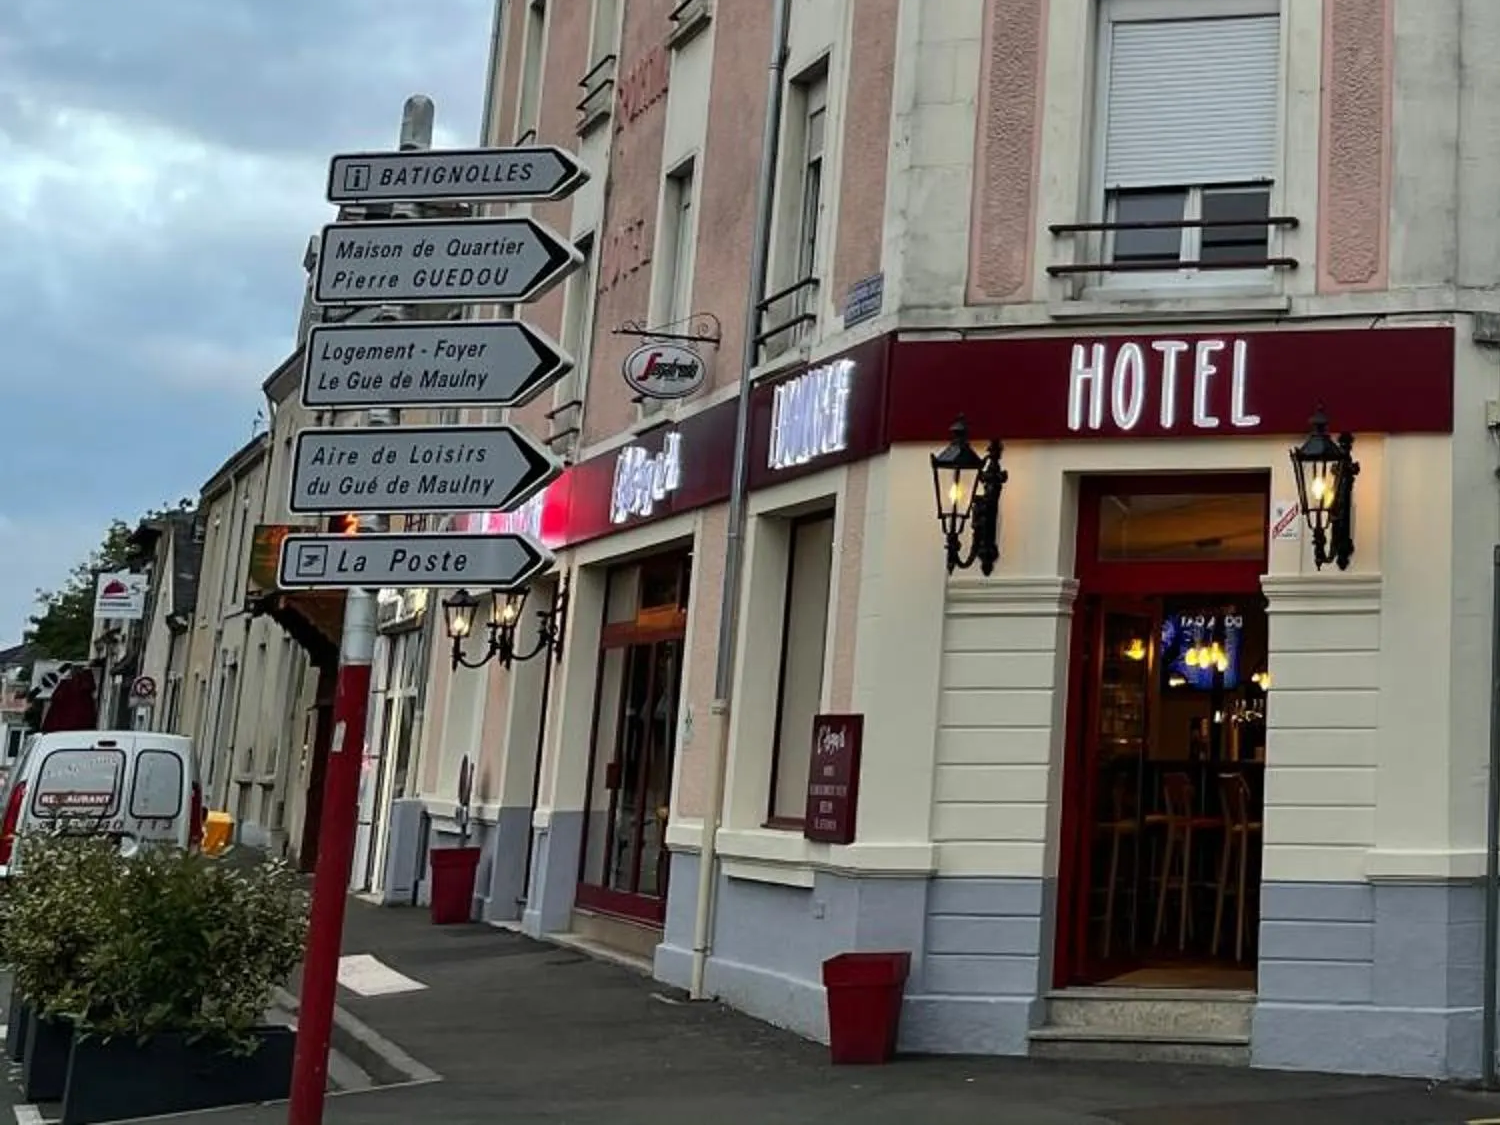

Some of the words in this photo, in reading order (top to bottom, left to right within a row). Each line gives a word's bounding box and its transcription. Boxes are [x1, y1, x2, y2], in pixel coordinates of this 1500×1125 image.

[379, 162, 534, 187] BATIGNOLLES
[335, 240, 403, 260] Maison
[412, 239, 435, 258] de
[446, 236, 525, 257] Quartier
[331, 270, 399, 290] Pierre
[412, 267, 509, 288] GUEDOU
[321, 341, 416, 365] Logement
[433, 339, 488, 363] Foyer
[317, 372, 339, 390] Le
[389, 371, 413, 388] de
[419, 370, 489, 391] Maulny
[1067, 338, 1261, 432] HOTEL
[311, 445, 359, 466] Aire
[371, 445, 397, 465] de
[409, 444, 487, 464] Loisirs
[307, 476, 331, 496] du
[338, 474, 378, 495] Gué
[386, 475, 410, 495] de
[417, 474, 495, 497] Maulny
[337, 548, 367, 573] La
[388, 548, 468, 573] Poste
